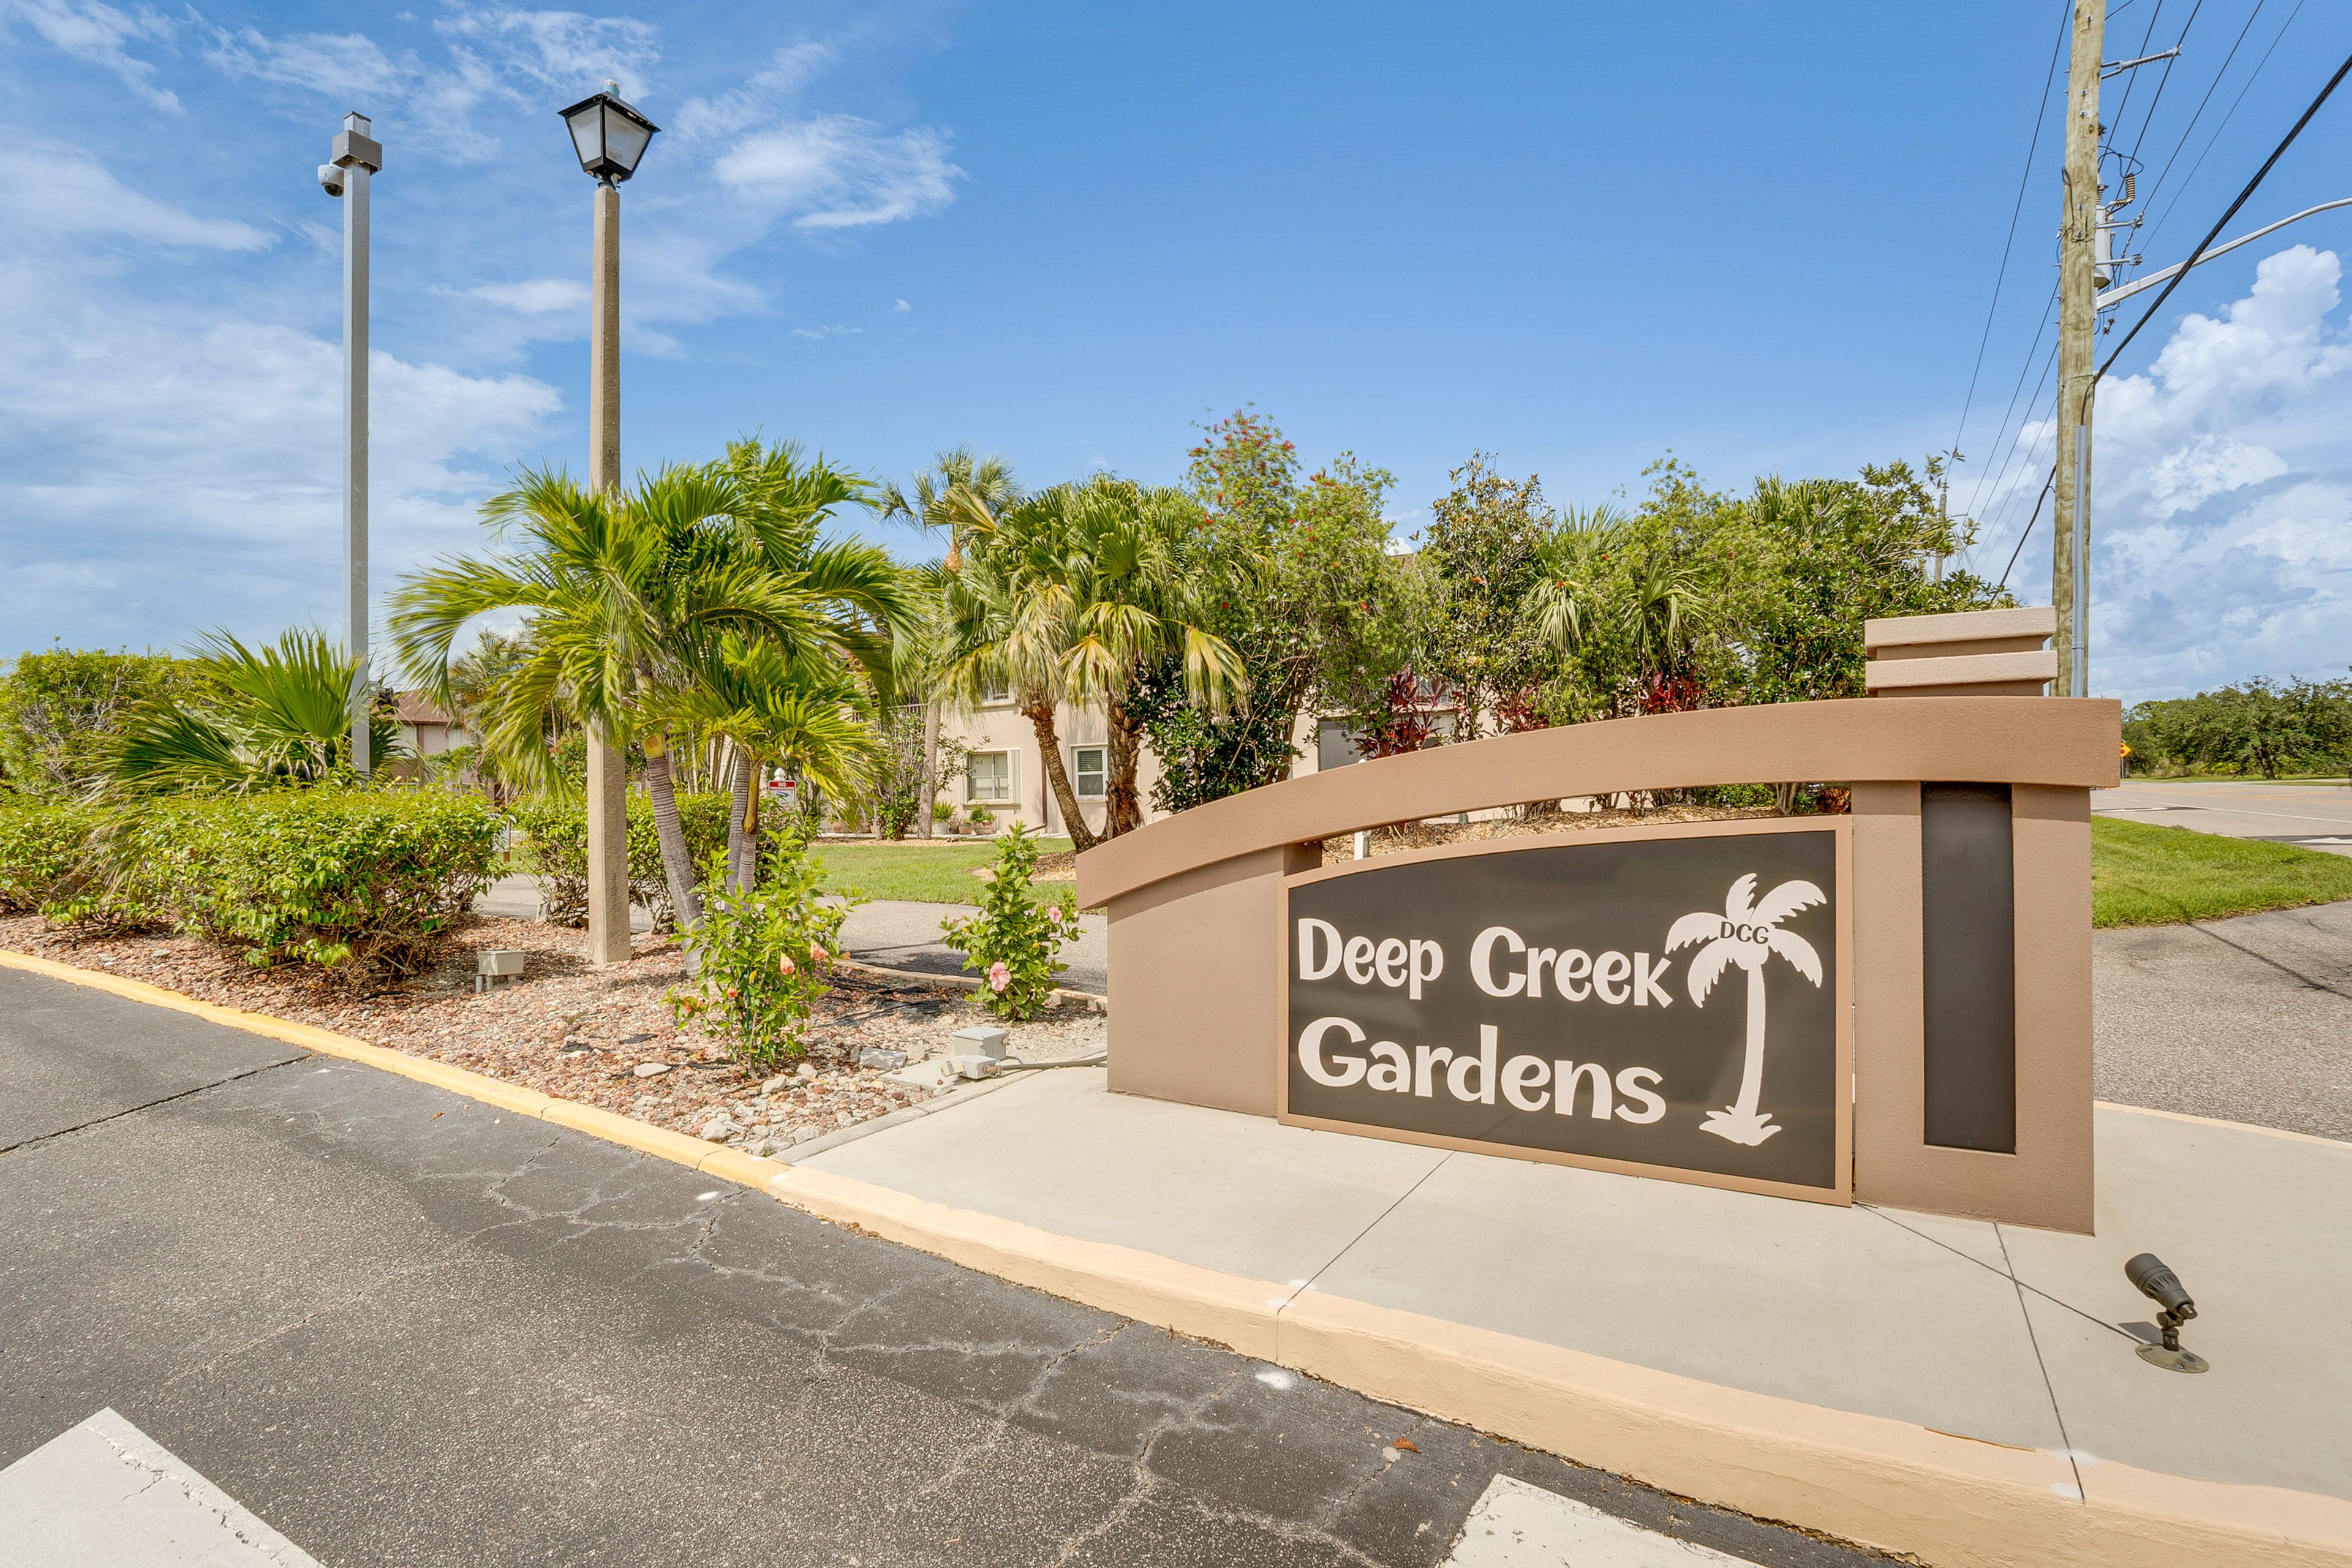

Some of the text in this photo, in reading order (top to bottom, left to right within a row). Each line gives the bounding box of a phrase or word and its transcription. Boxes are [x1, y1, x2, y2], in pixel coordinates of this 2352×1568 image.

[1297, 918, 1674, 1009] Deep Creek
[1720, 921, 1769, 944] DCG
[1297, 1016, 1667, 1125] Gardens
